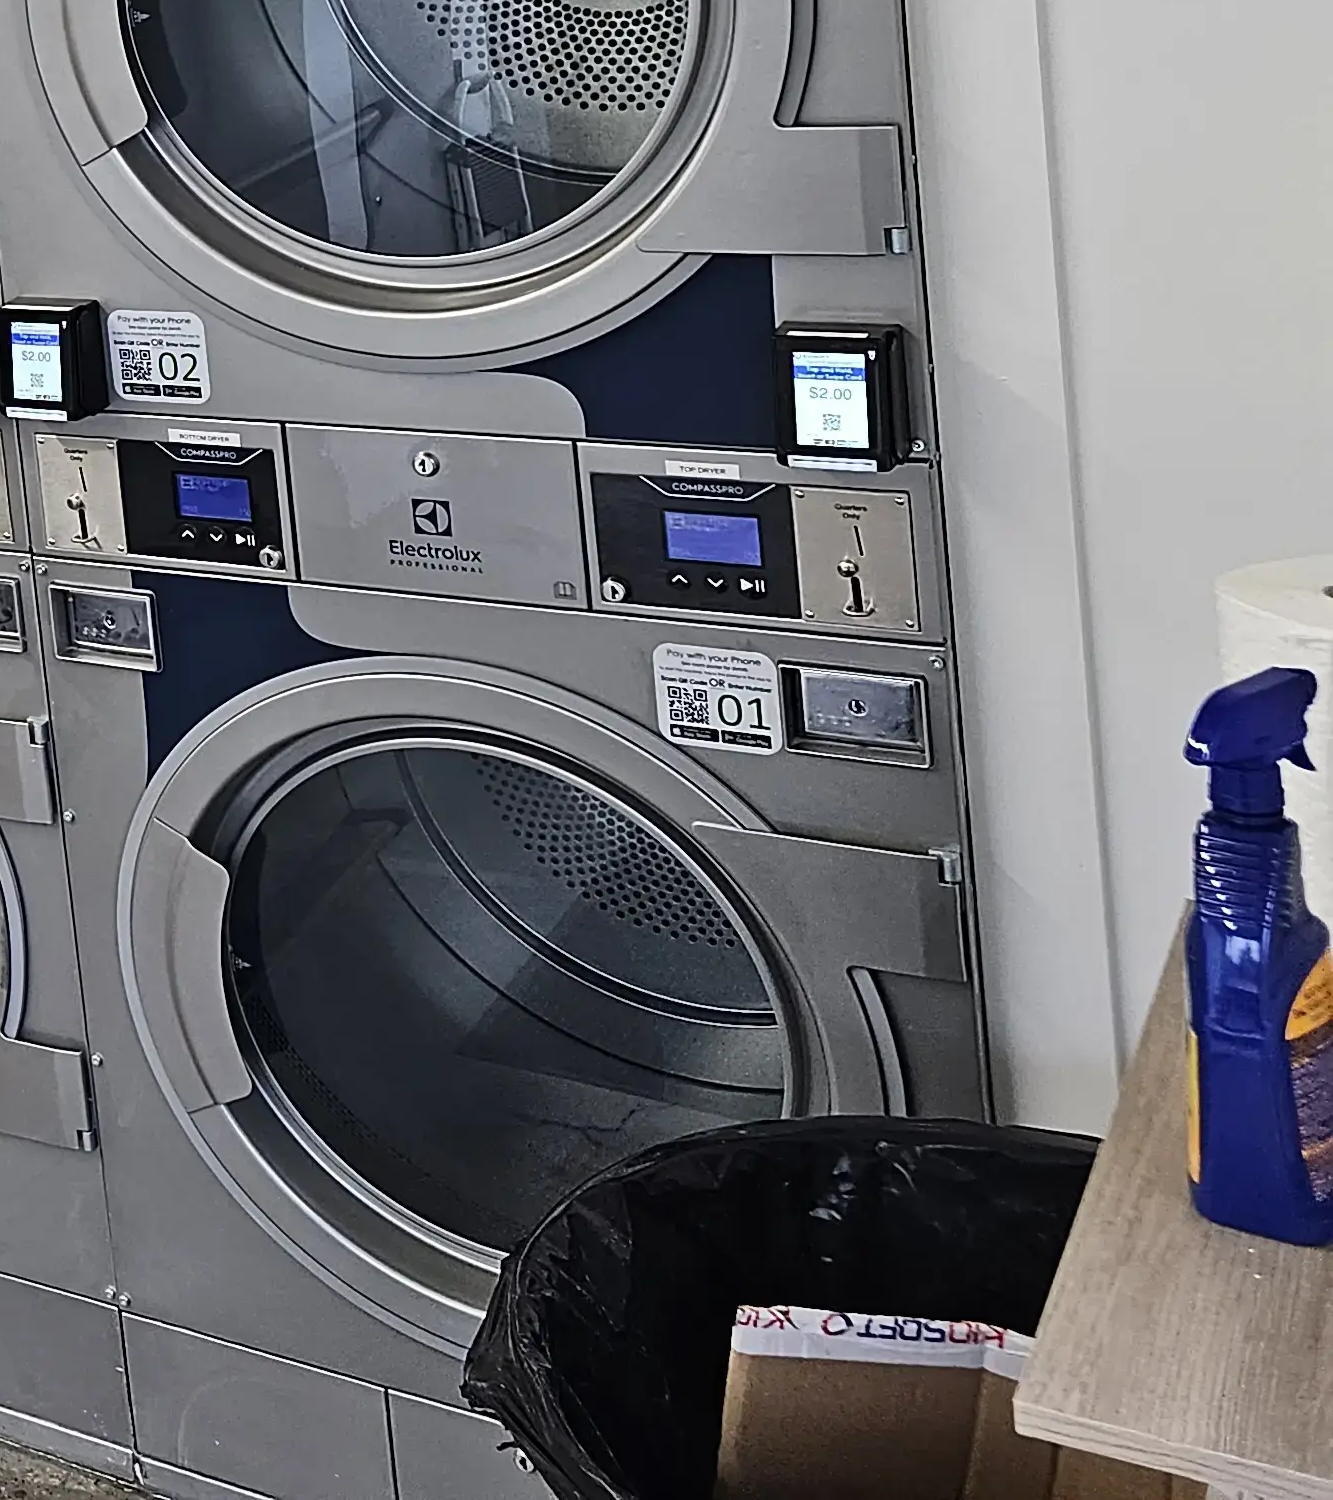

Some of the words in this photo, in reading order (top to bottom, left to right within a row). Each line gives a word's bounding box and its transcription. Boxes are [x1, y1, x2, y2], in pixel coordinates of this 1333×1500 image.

[117, 315, 131, 323] Pay
[151, 338, 164, 347] OR
[21, 350, 51, 362] $2.00
[158, 352, 201, 382] 02
[809, 386, 852, 400] $2.00
[179, 433, 205, 442] BOTTOM
[207, 435, 230, 443] DRYER
[180, 448, 237, 460] COMPASSPRO
[679, 465, 696, 474] TOP
[698, 466, 726, 475] DRYER
[671, 482, 744, 495] COMPASSPRO
[834, 503, 867, 512] Quarters
[842, 512, 861, 521] Only
[389, 539, 483, 563] Electrolux
[390, 559, 483, 574] PROFESSIONAL
[666, 649, 683, 658] Pay
[686, 652, 705, 660] with
[708, 655, 728, 663] your
[731, 656, 761, 666] Phone
[709, 677, 726, 688] OR
[717, 694, 771, 731] 01
[856, 1316, 1008, 1349] KIOSOFT
